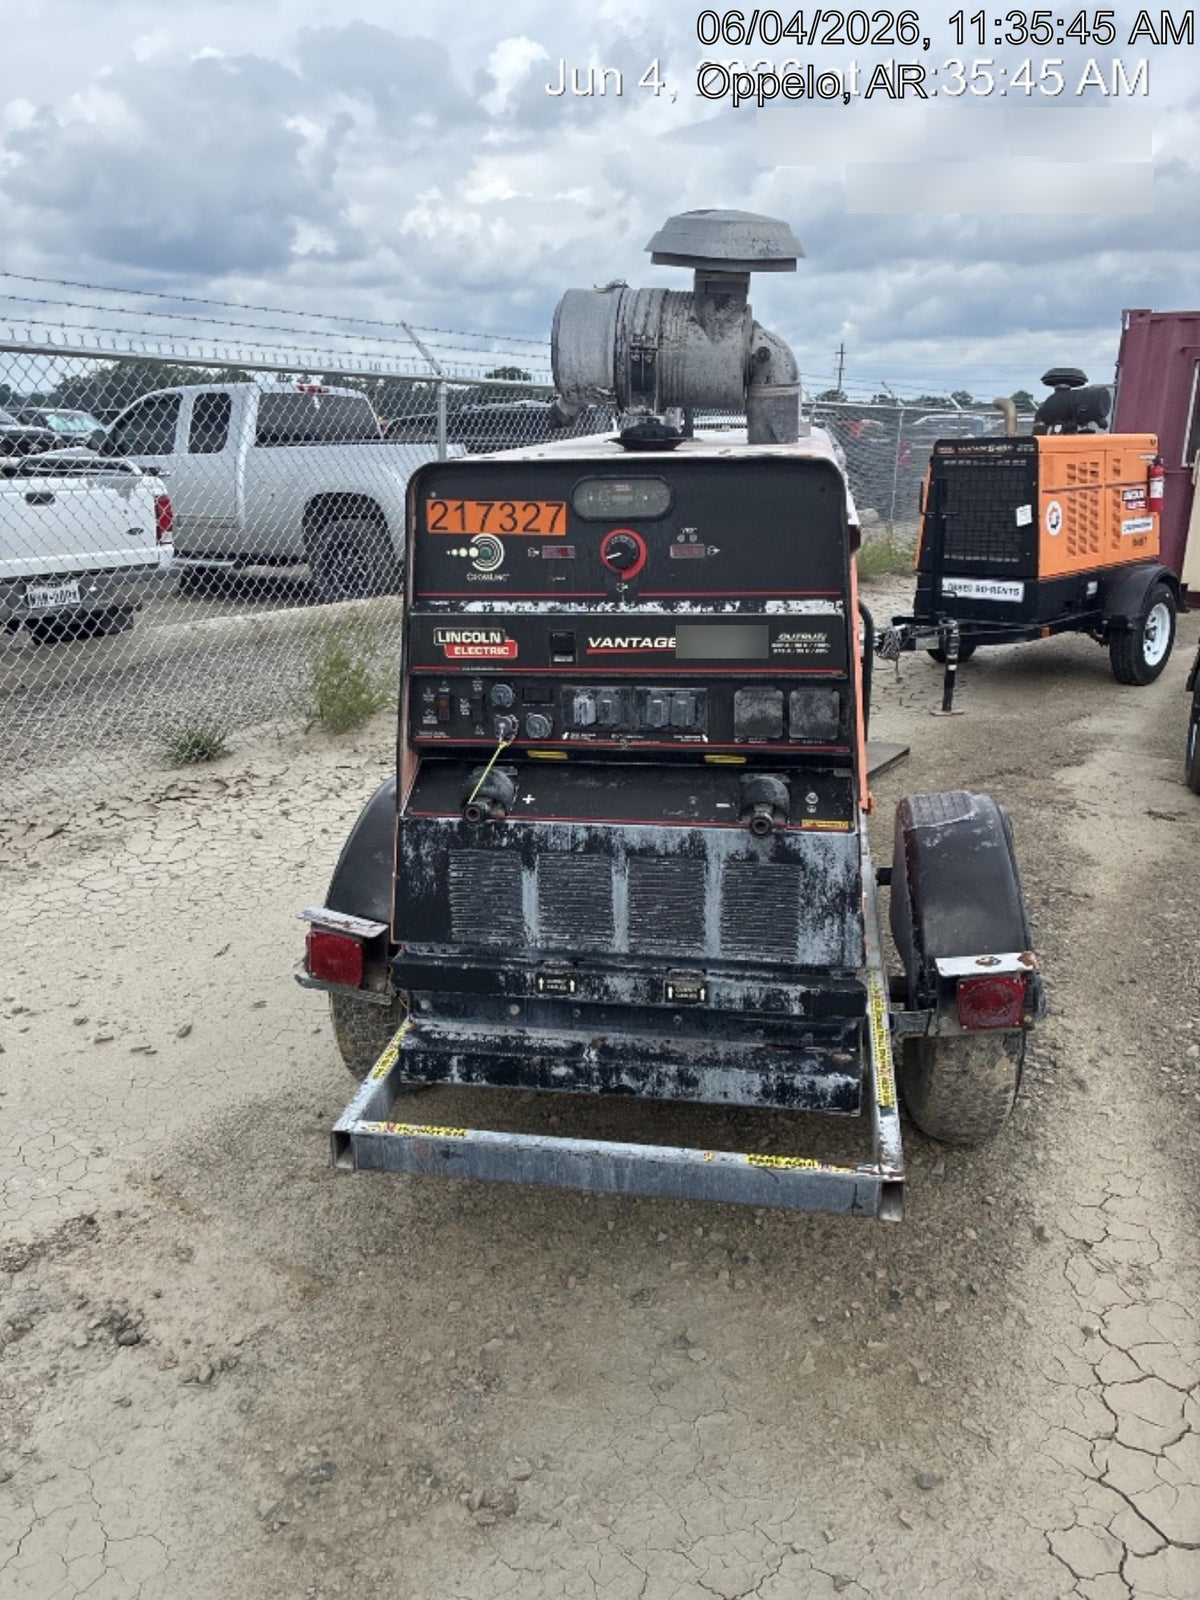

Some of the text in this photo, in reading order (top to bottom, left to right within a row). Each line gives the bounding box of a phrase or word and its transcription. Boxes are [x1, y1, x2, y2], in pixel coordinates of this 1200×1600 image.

[430, 500, 564, 534] 217327
[438, 631, 502, 644] LINCOLN
[588, 637, 676, 648] VANTAGE
[454, 646, 510, 655] ELECTRIC
